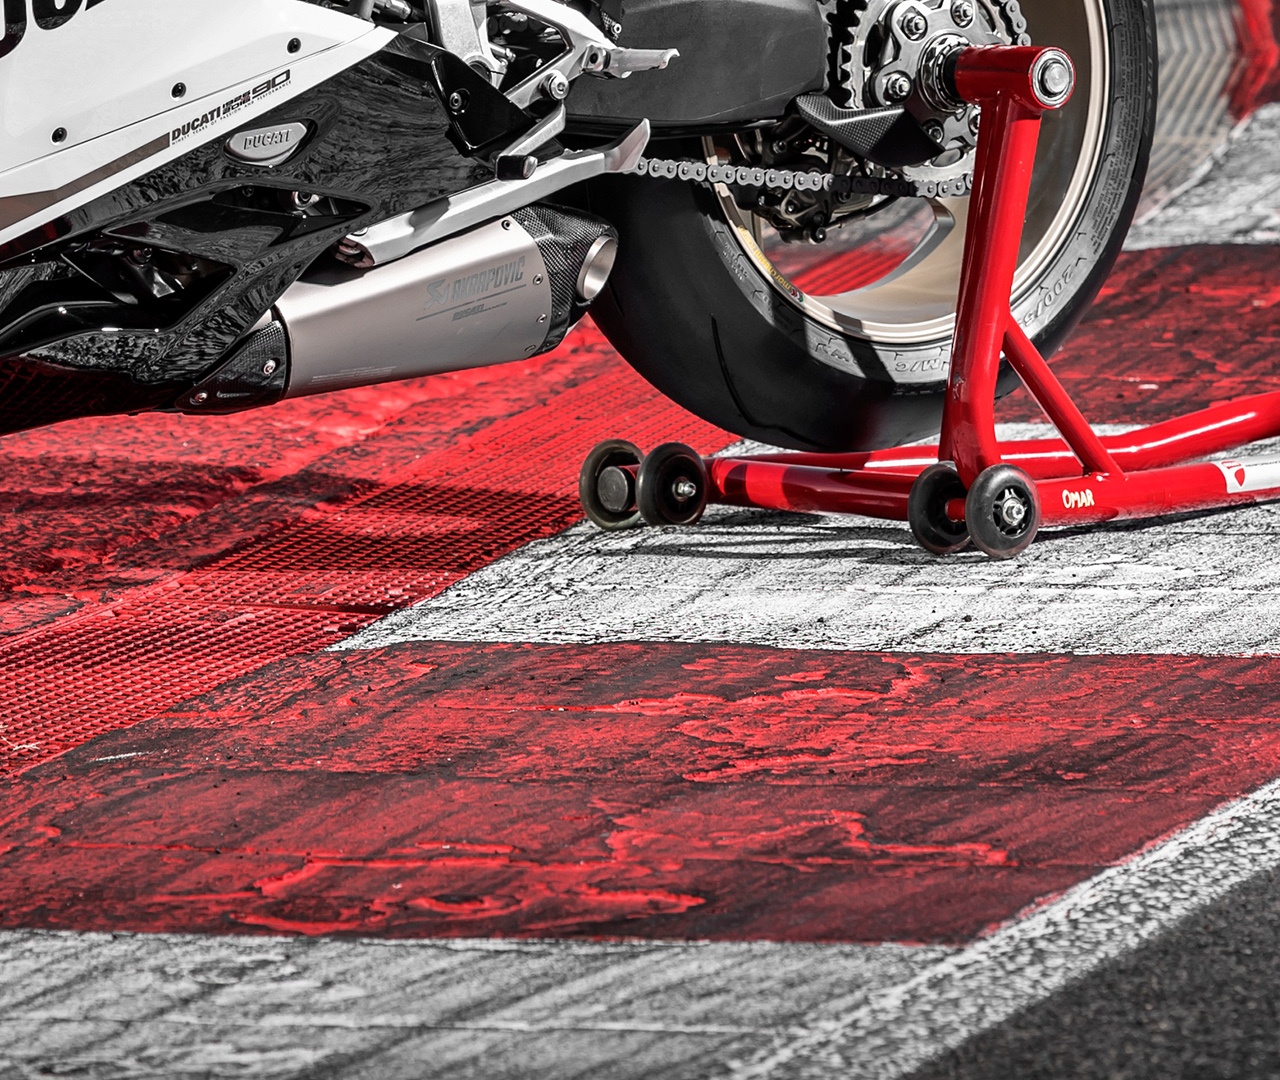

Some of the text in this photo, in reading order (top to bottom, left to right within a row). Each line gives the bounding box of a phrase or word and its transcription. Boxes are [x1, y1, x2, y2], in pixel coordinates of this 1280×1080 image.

[171, 106, 221, 141] DUCATI
[252, 69, 291, 100] 90
[243, 128, 292, 150] DUCATI
[1061, 488, 1095, 509] OMAR
